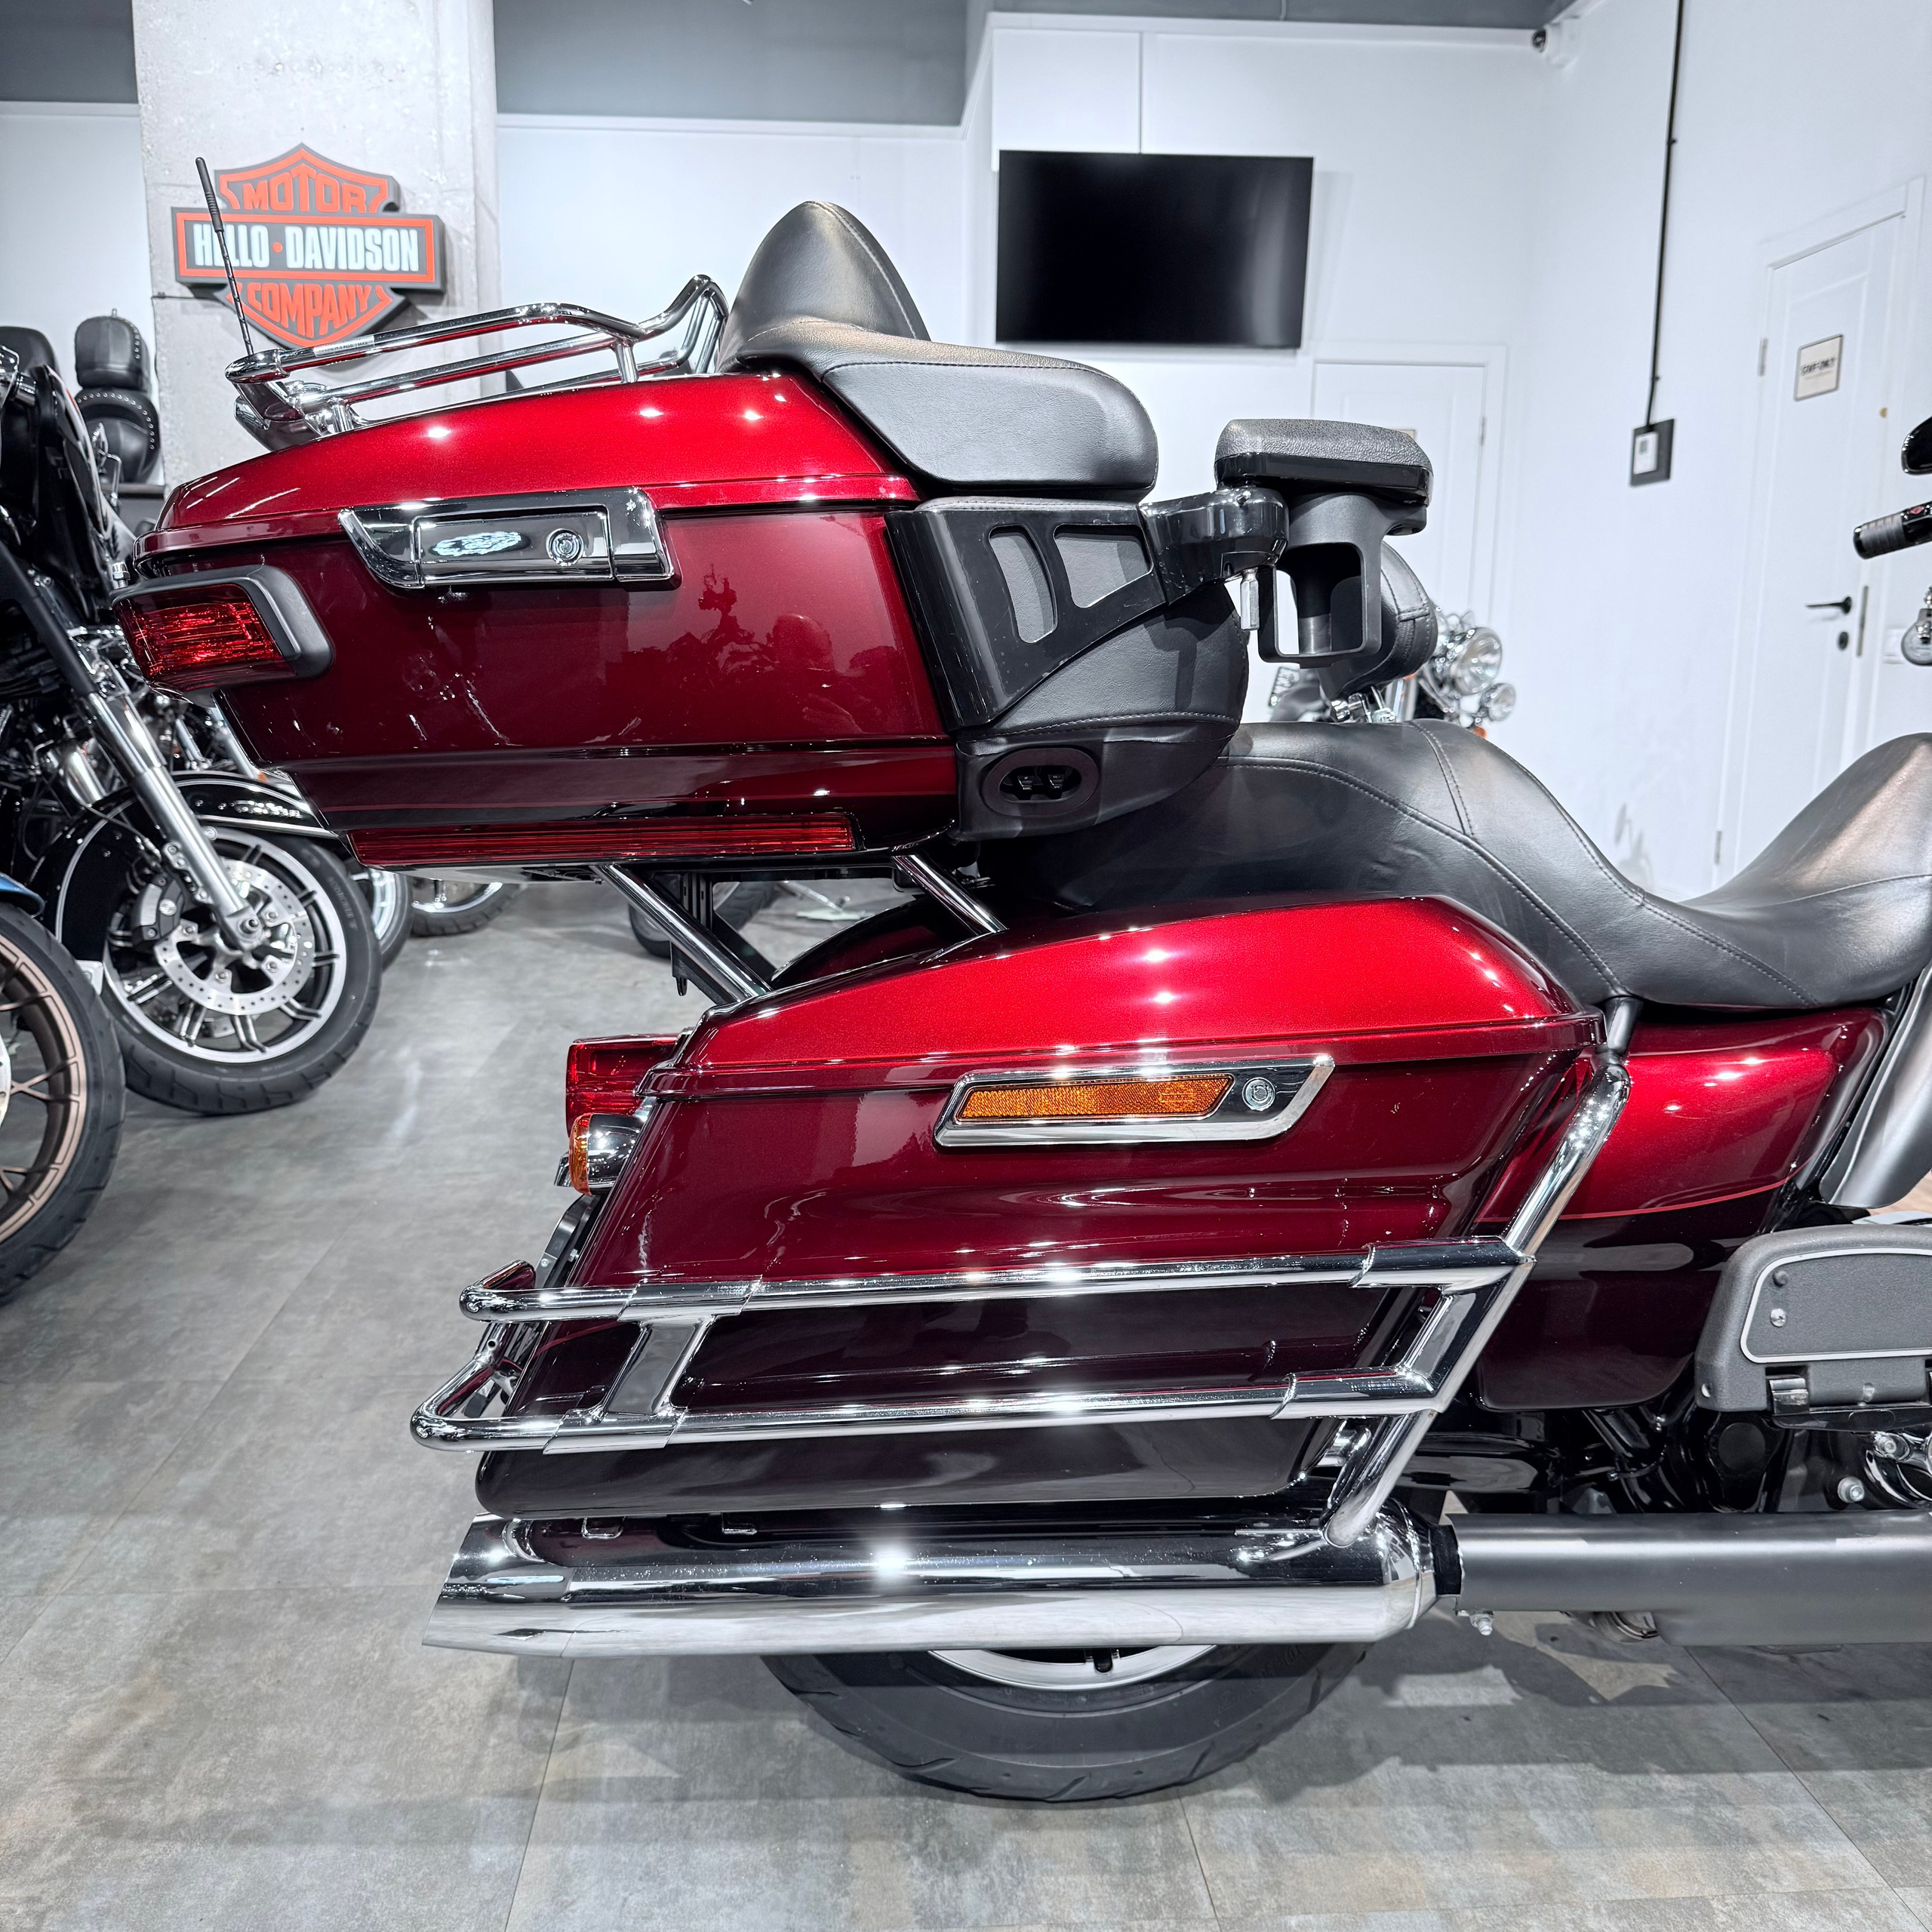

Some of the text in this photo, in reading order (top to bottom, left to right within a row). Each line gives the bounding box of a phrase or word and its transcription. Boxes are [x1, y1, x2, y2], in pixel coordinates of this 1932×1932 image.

[242, 163, 367, 214] MOTOR
[285, 226, 420, 272] DAVIDSON
[246, 282, 372, 339] COMPANY
